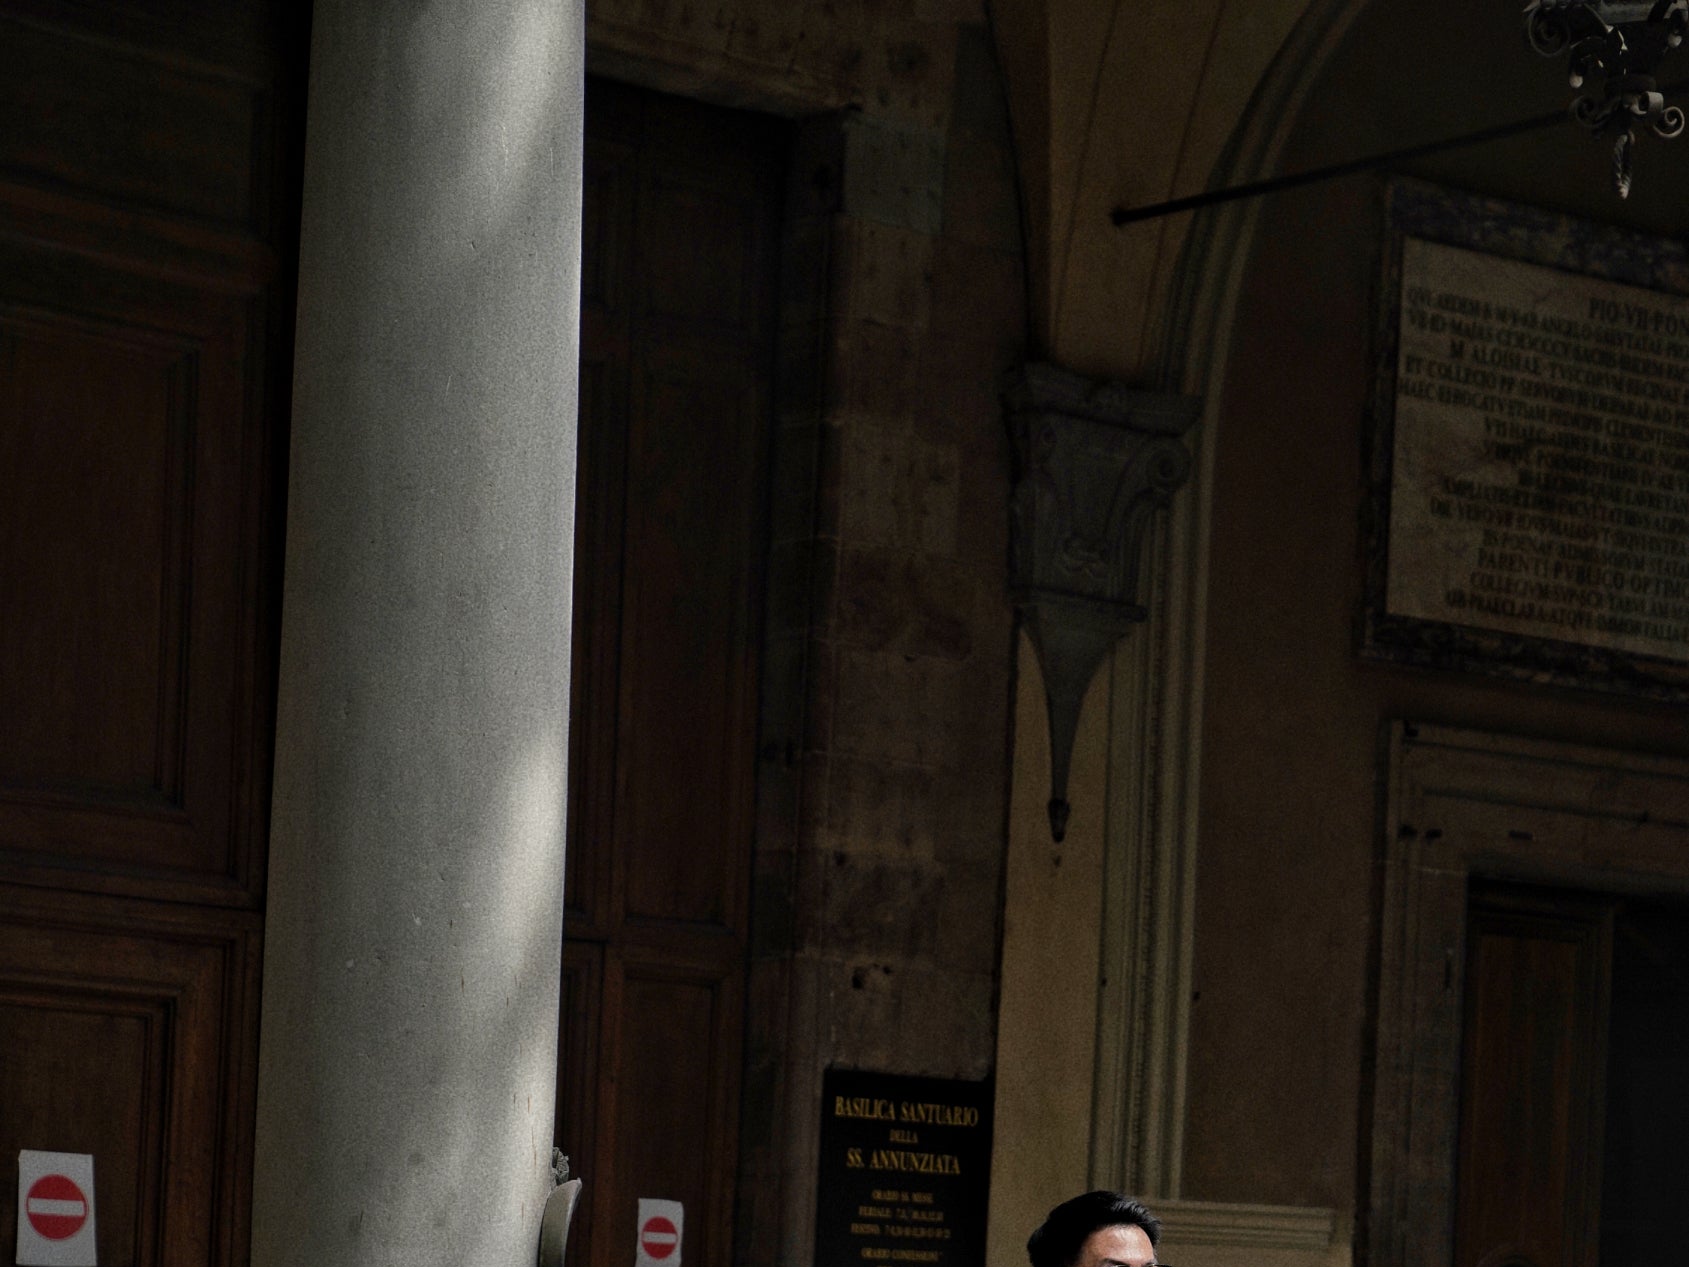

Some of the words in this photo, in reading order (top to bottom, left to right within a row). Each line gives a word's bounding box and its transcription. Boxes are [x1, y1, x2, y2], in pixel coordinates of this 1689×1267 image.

[834, 1095, 896, 1121] BASILICA
[899, 1100, 979, 1127] SANTUARIO
[889, 1128, 919, 1144] DELLA
[869, 1149, 961, 1176] ANNUNZIATA
